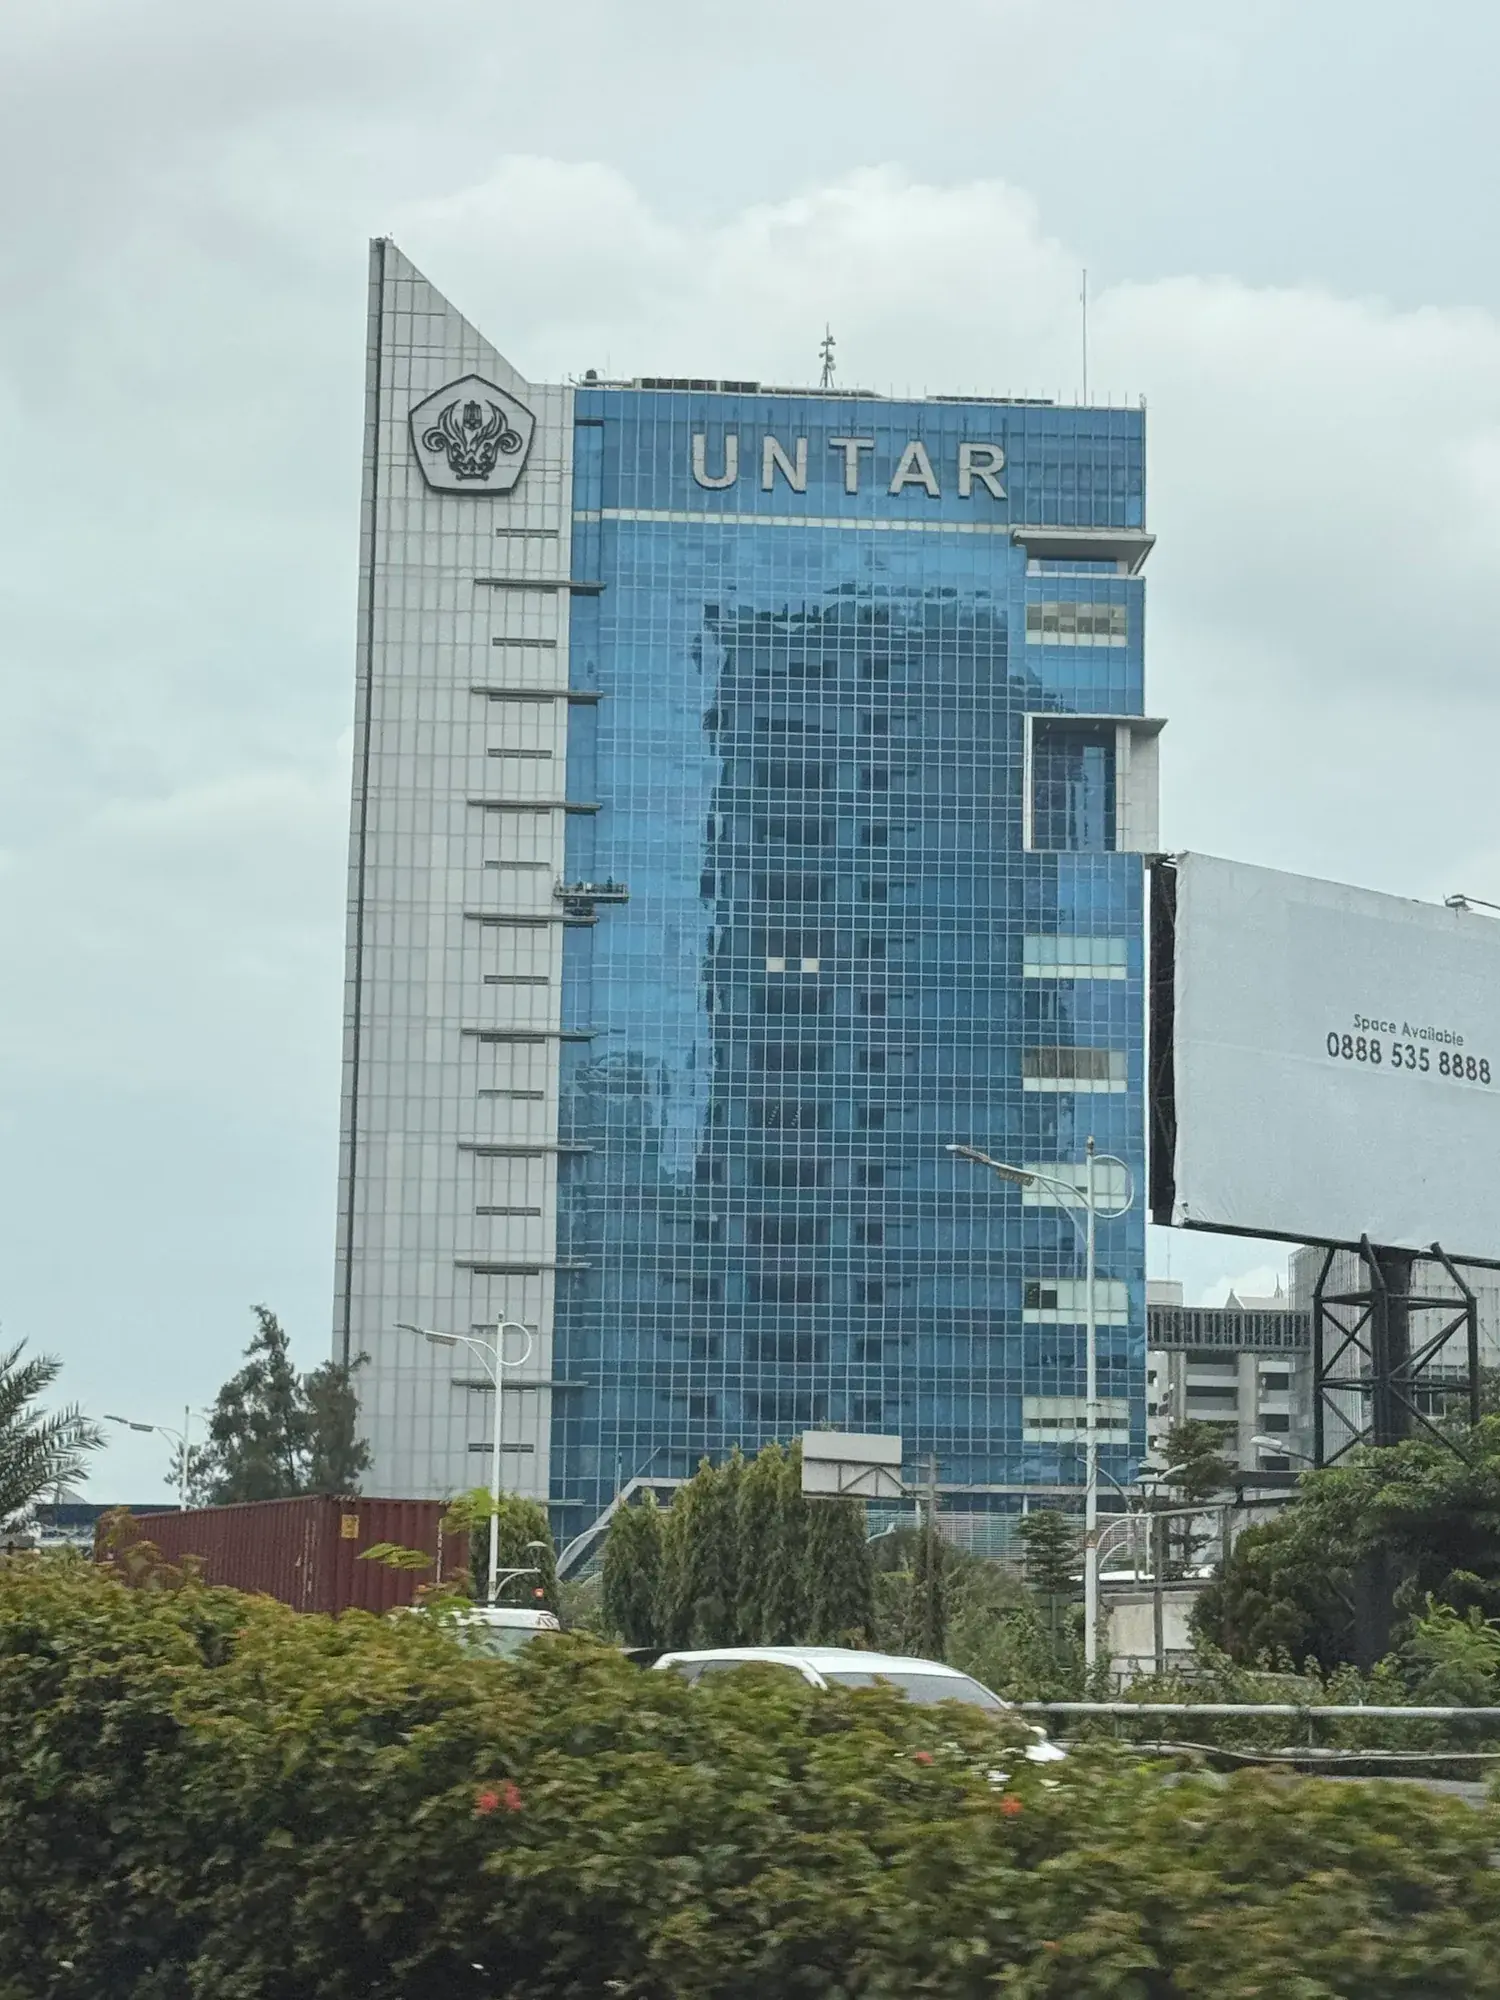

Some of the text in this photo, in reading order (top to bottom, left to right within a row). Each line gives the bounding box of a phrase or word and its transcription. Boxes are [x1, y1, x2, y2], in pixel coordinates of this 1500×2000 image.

[692, 434, 1009, 500] UNTAR
[1353, 1013, 1464, 1046] Space Available
[1326, 1032, 1491, 1085] 0888 535 8888
